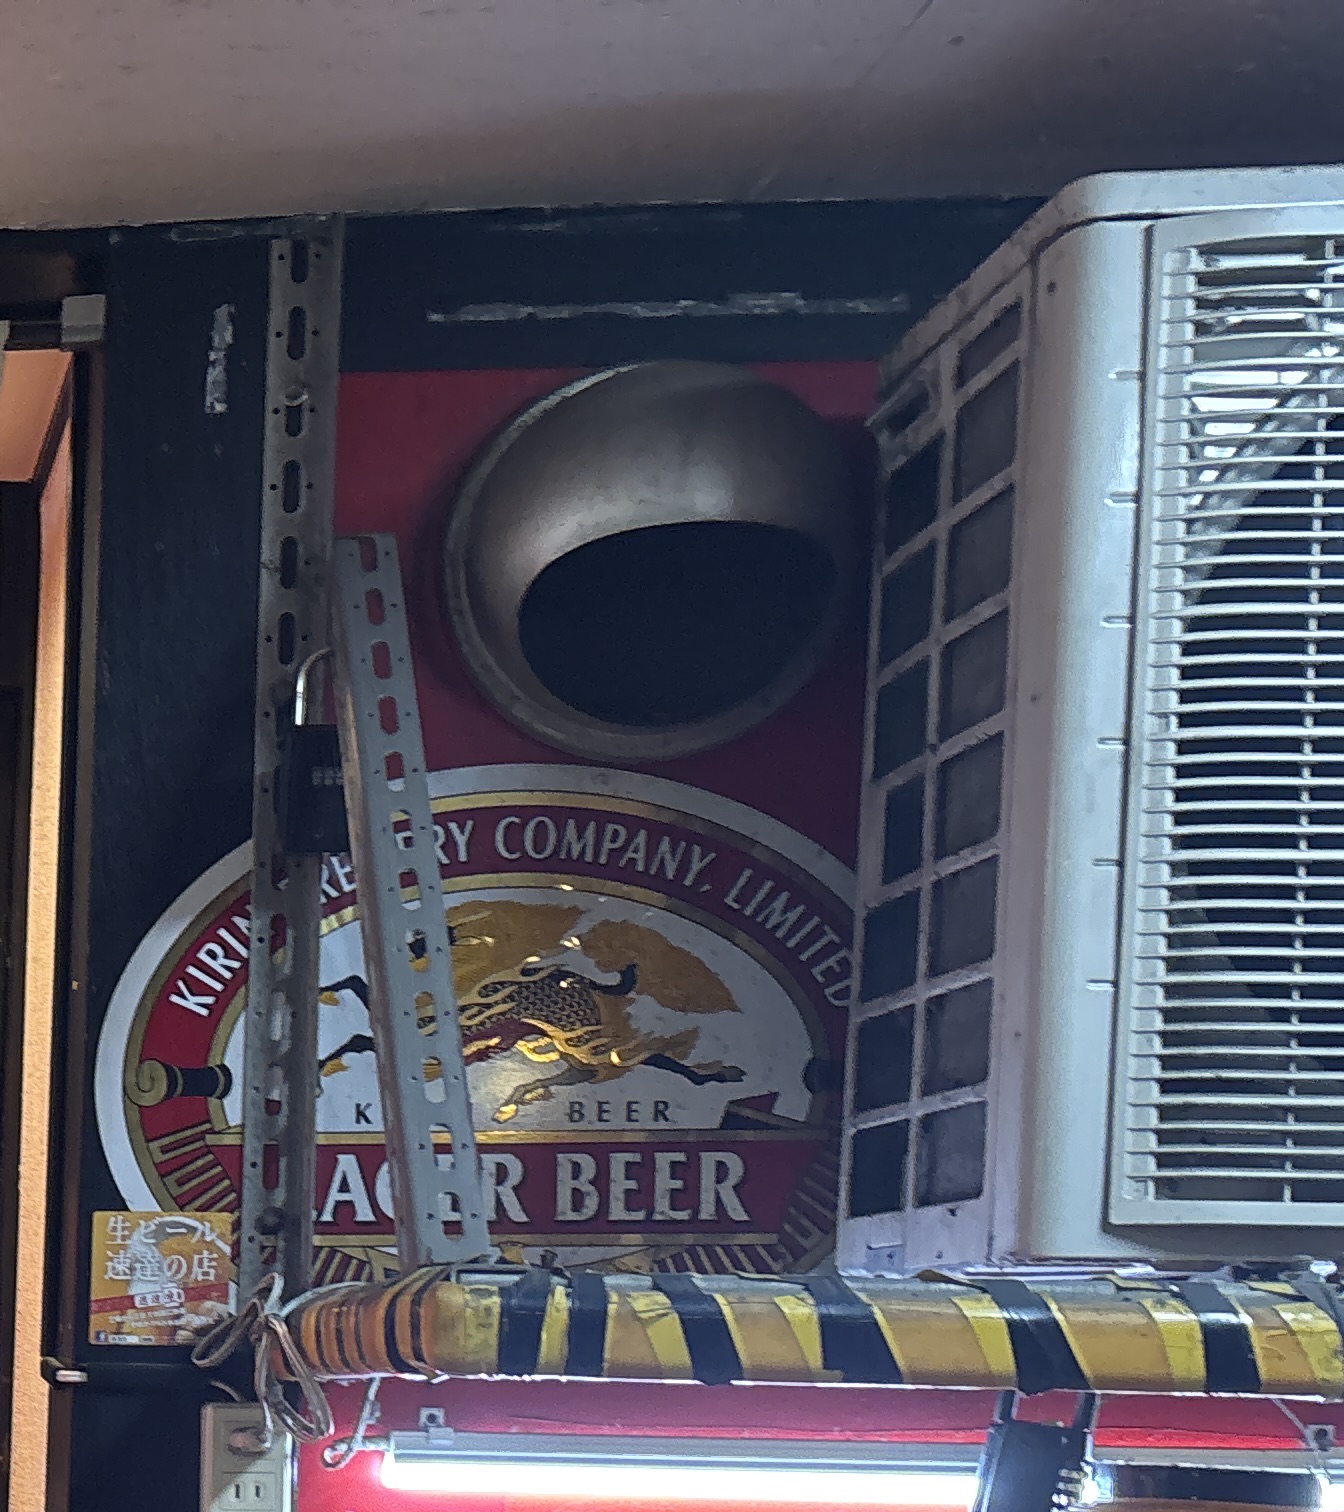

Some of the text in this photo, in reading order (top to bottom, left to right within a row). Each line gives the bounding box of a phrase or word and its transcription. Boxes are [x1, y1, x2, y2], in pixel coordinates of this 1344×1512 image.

[495, 816, 716, 893] COMPANY,
[569, 1100, 671, 1124] BEER
[554, 1151, 751, 1222] BEER
[105, 1215, 218, 1245] 生ビール
